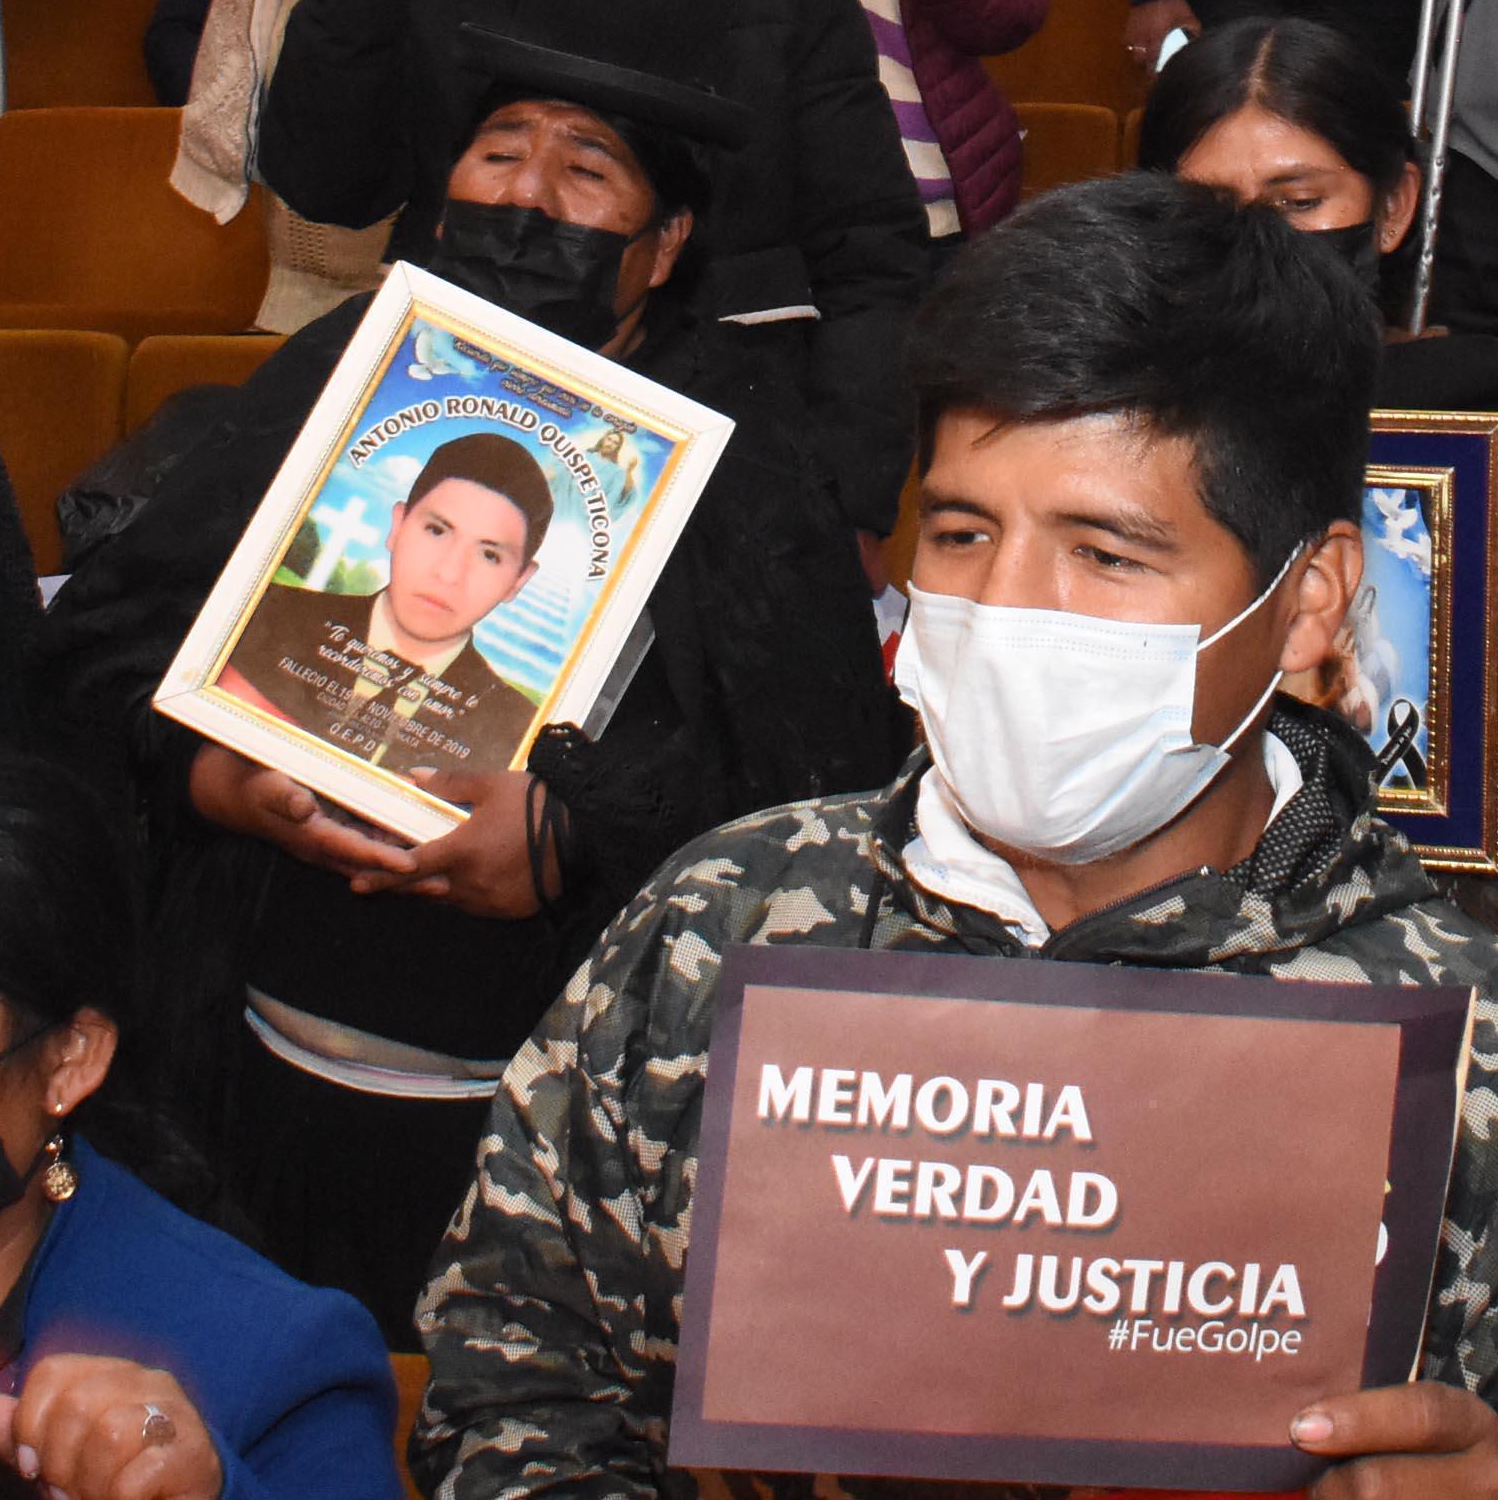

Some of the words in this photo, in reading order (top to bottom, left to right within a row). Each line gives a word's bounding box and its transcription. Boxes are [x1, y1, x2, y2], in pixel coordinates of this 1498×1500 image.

[349, 401, 441, 468] ANTONIO
[446, 396, 538, 431] RONALD
[539, 424, 599, 493] QUISPE
[586, 492, 611, 580] TICONA
[277, 656, 329, 688] FALLECIO
[442, 738, 471, 759] 2019
[758, 1063, 1093, 1143] MEMORIA
[832, 1154, 1119, 1228] VERDAD
[944, 1249, 988, 1306] Y
[1002, 1253, 1307, 1318] JUSTICIA
[1108, 1319, 1302, 1363] #FueGolpe
